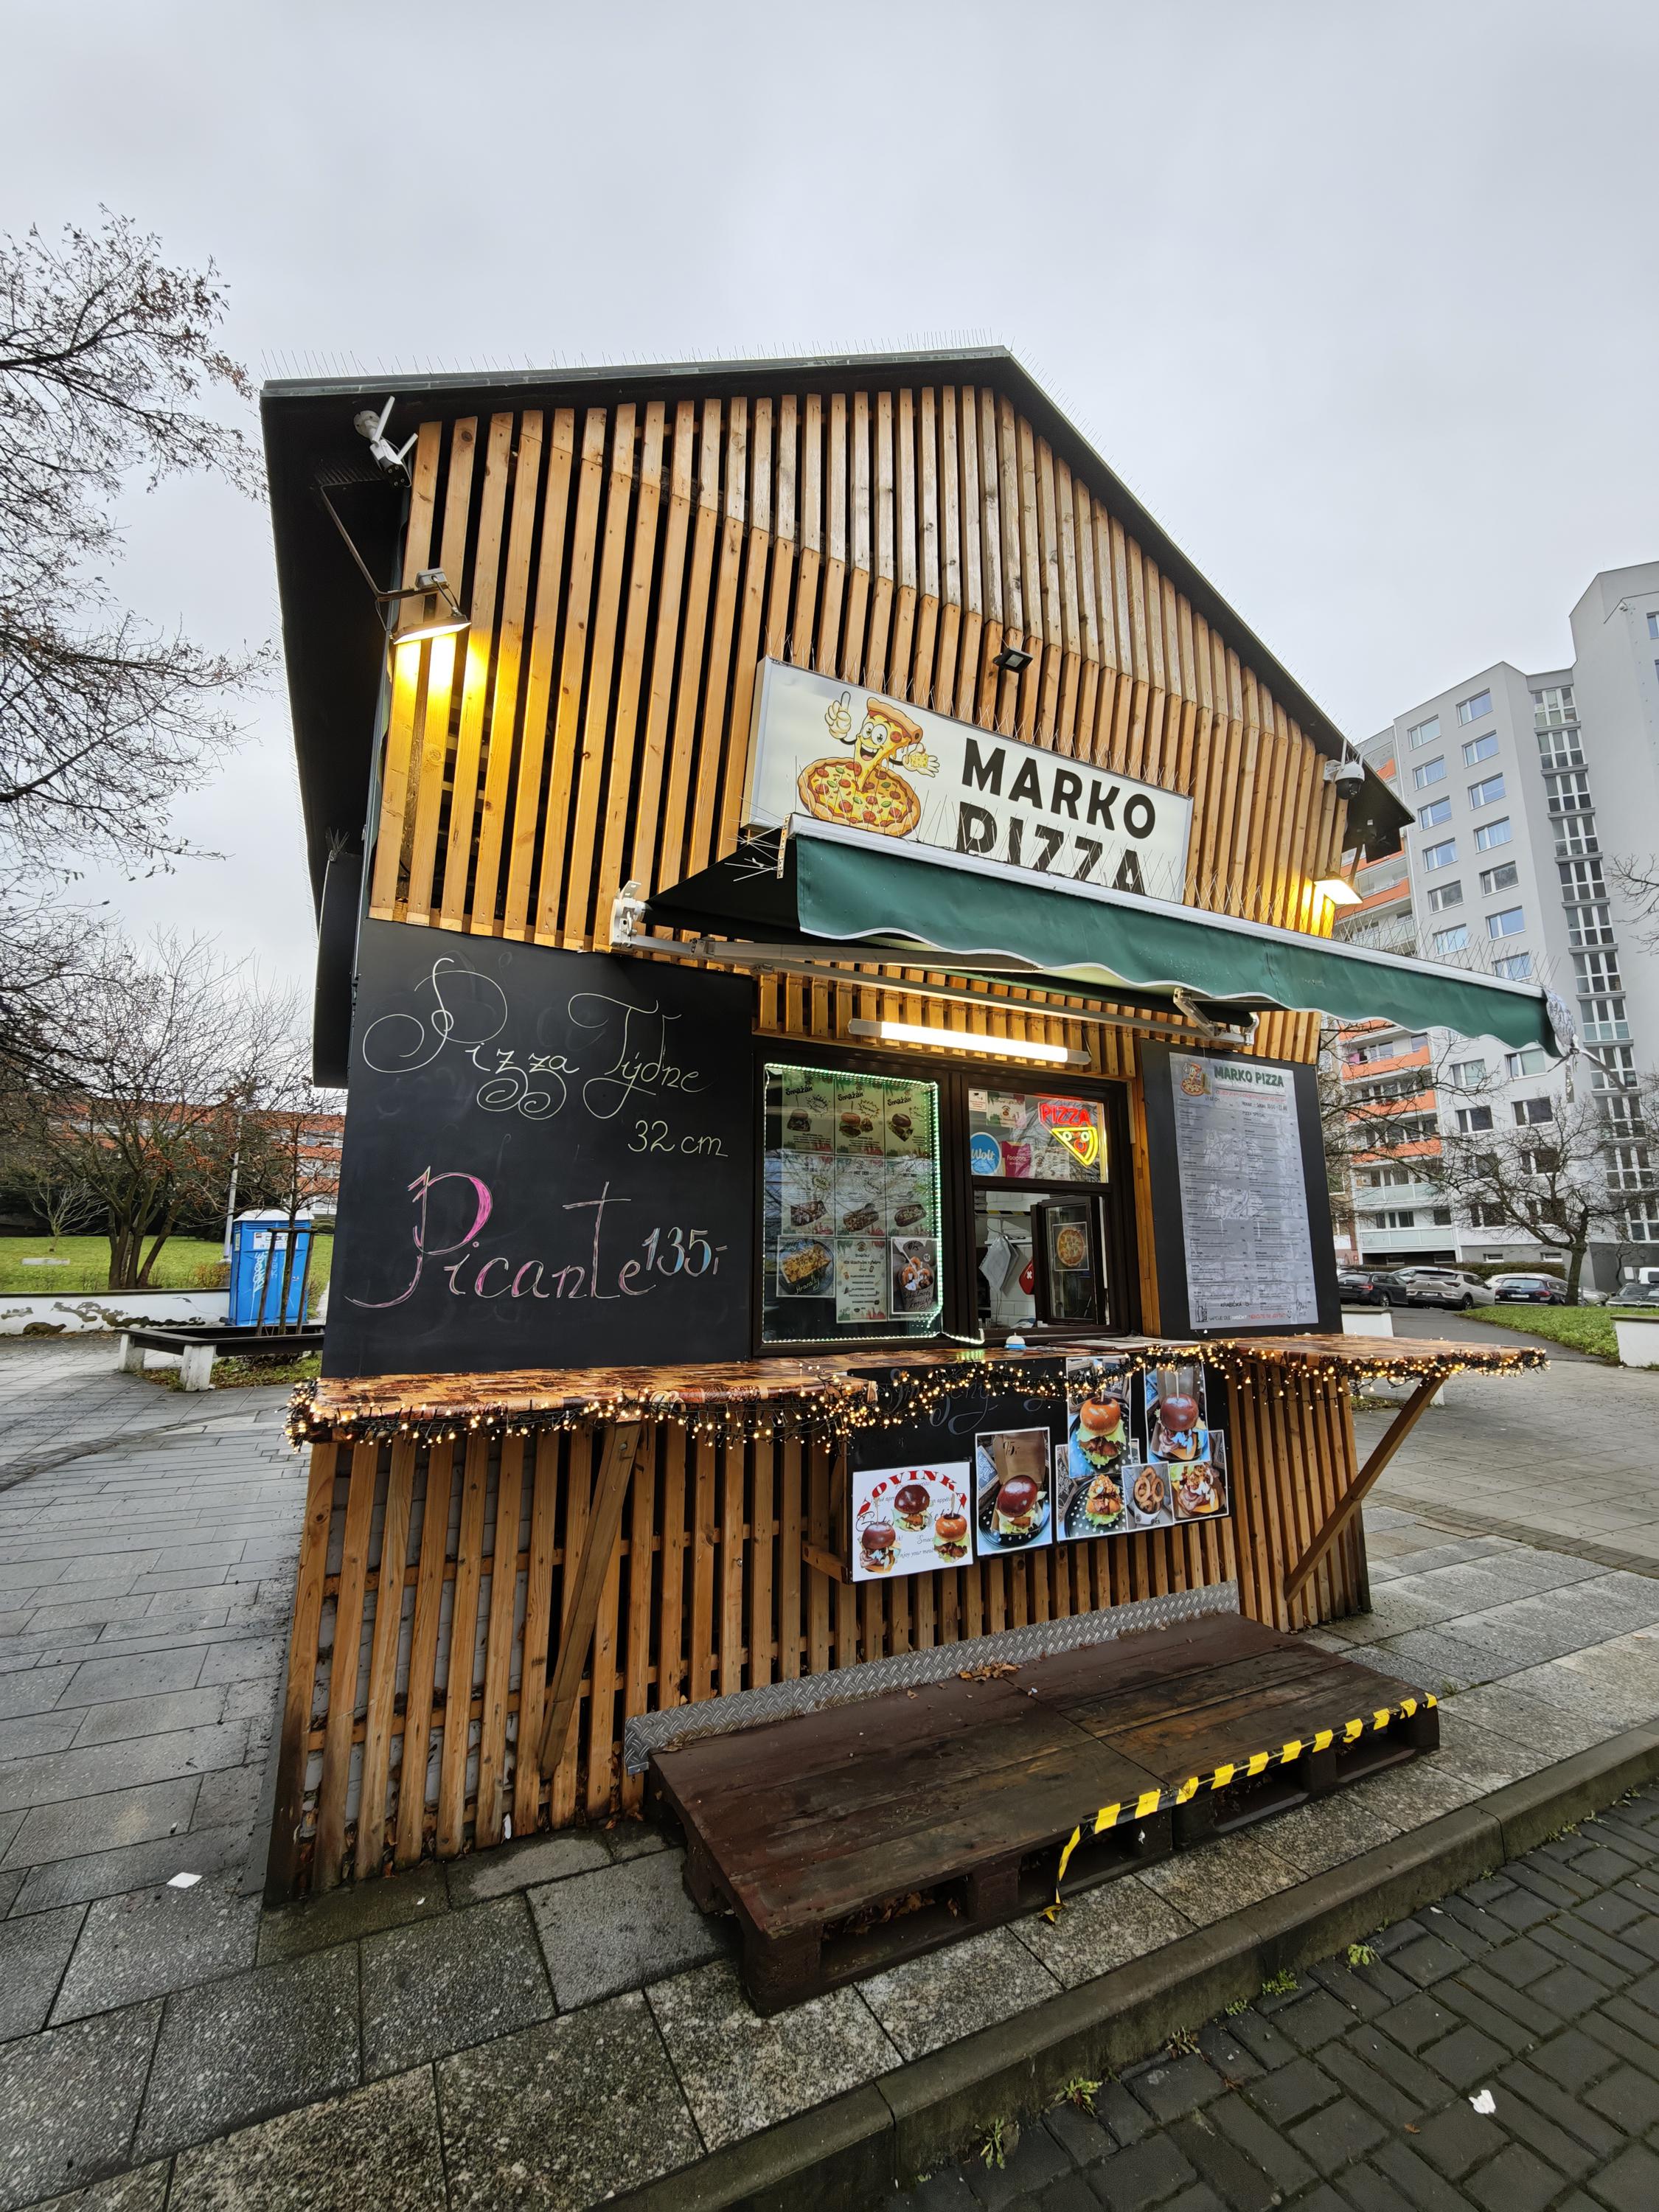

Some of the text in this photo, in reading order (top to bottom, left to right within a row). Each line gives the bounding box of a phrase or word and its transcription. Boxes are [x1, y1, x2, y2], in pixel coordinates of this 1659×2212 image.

[961, 737, 1155, 839] MARKO
[956, 801, 1146, 895] PIZZA
[363, 958, 580, 1120] Pizza
[1214, 1065, 1284, 1088] MARKO PIZZA
[627, 1120, 728, 1158] 32 cm
[1040, 1102, 1093, 1127] PIZZA
[971, 1148, 995, 1161] Wolt
[344, 1166, 656, 1308] Picante
[857, 1470, 967, 1521] NOVINKA
